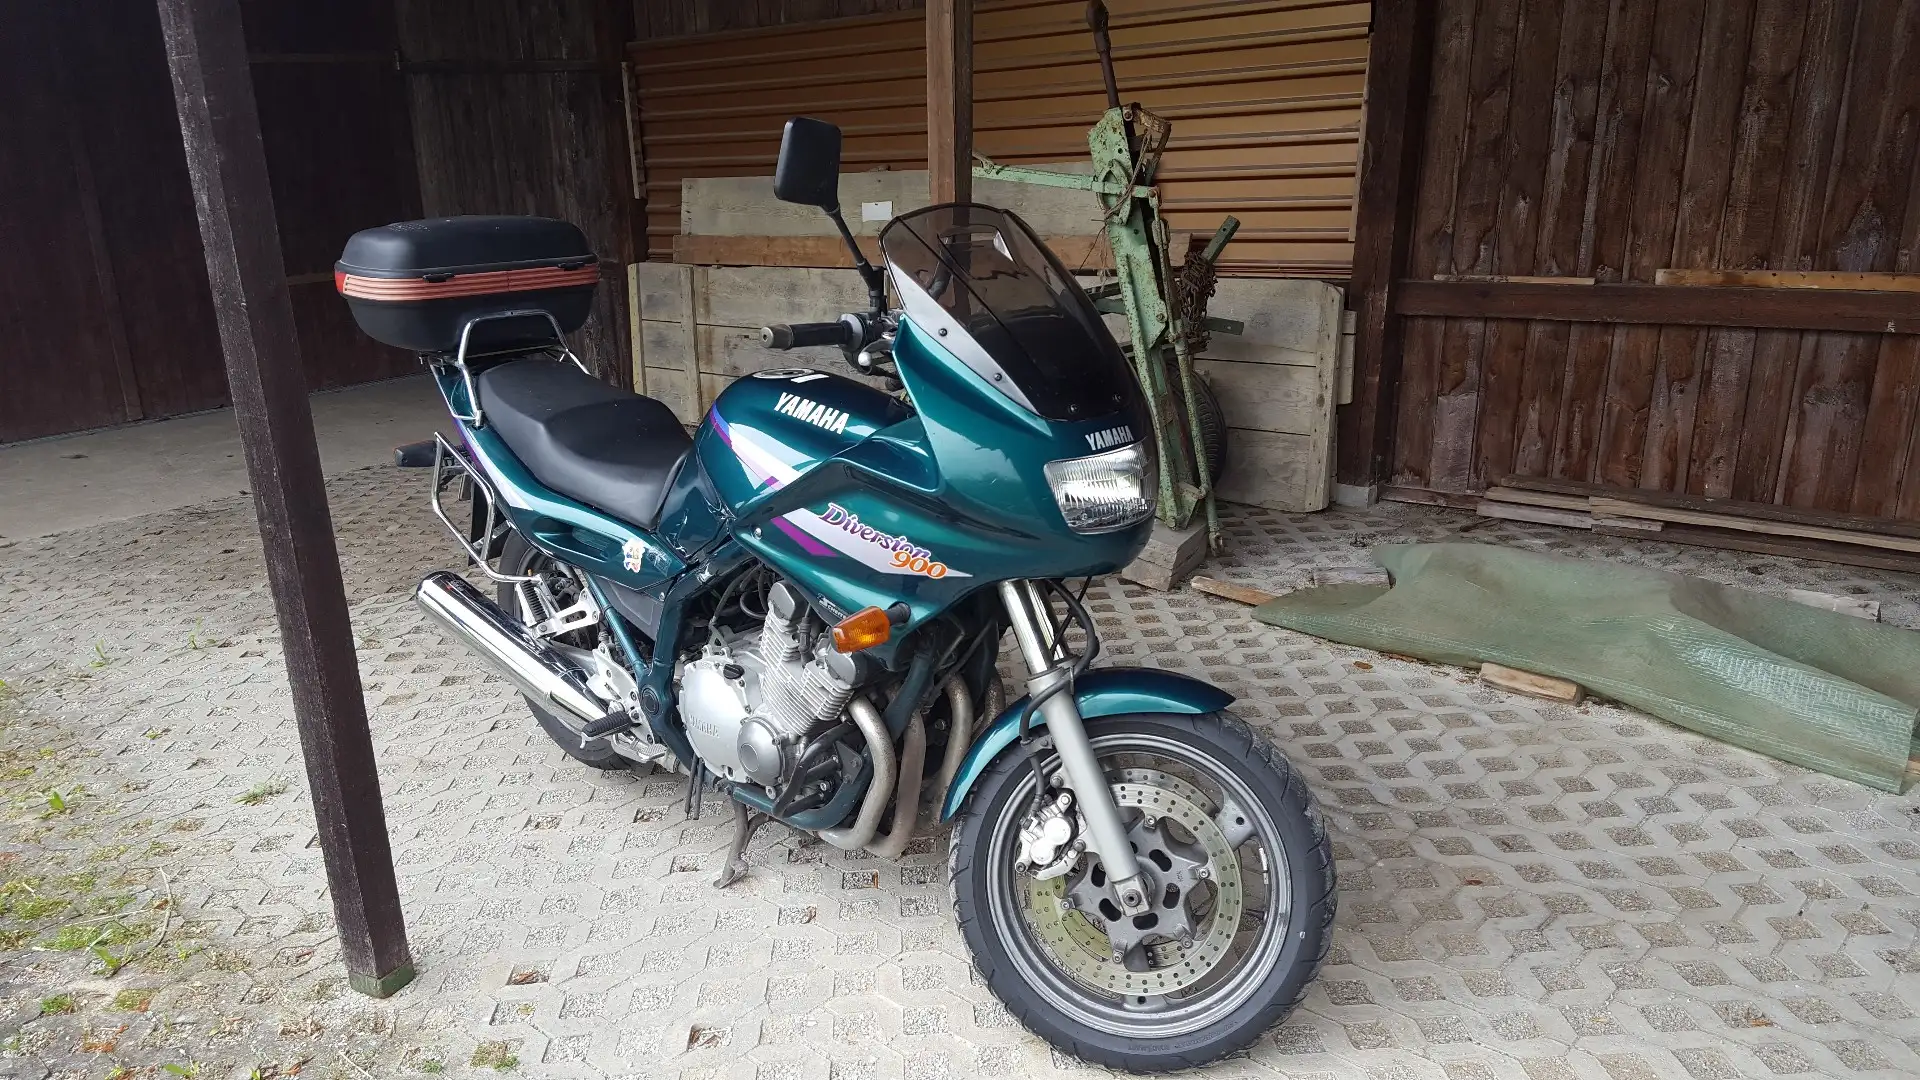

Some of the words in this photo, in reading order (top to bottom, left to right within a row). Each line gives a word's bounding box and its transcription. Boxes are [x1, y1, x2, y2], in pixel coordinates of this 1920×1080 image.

[773, 391, 850, 435] YAMAHA
[1085, 425, 1135, 451] YAMAHA
[818, 502, 931, 560] Diversion
[889, 550, 948, 579] 900
